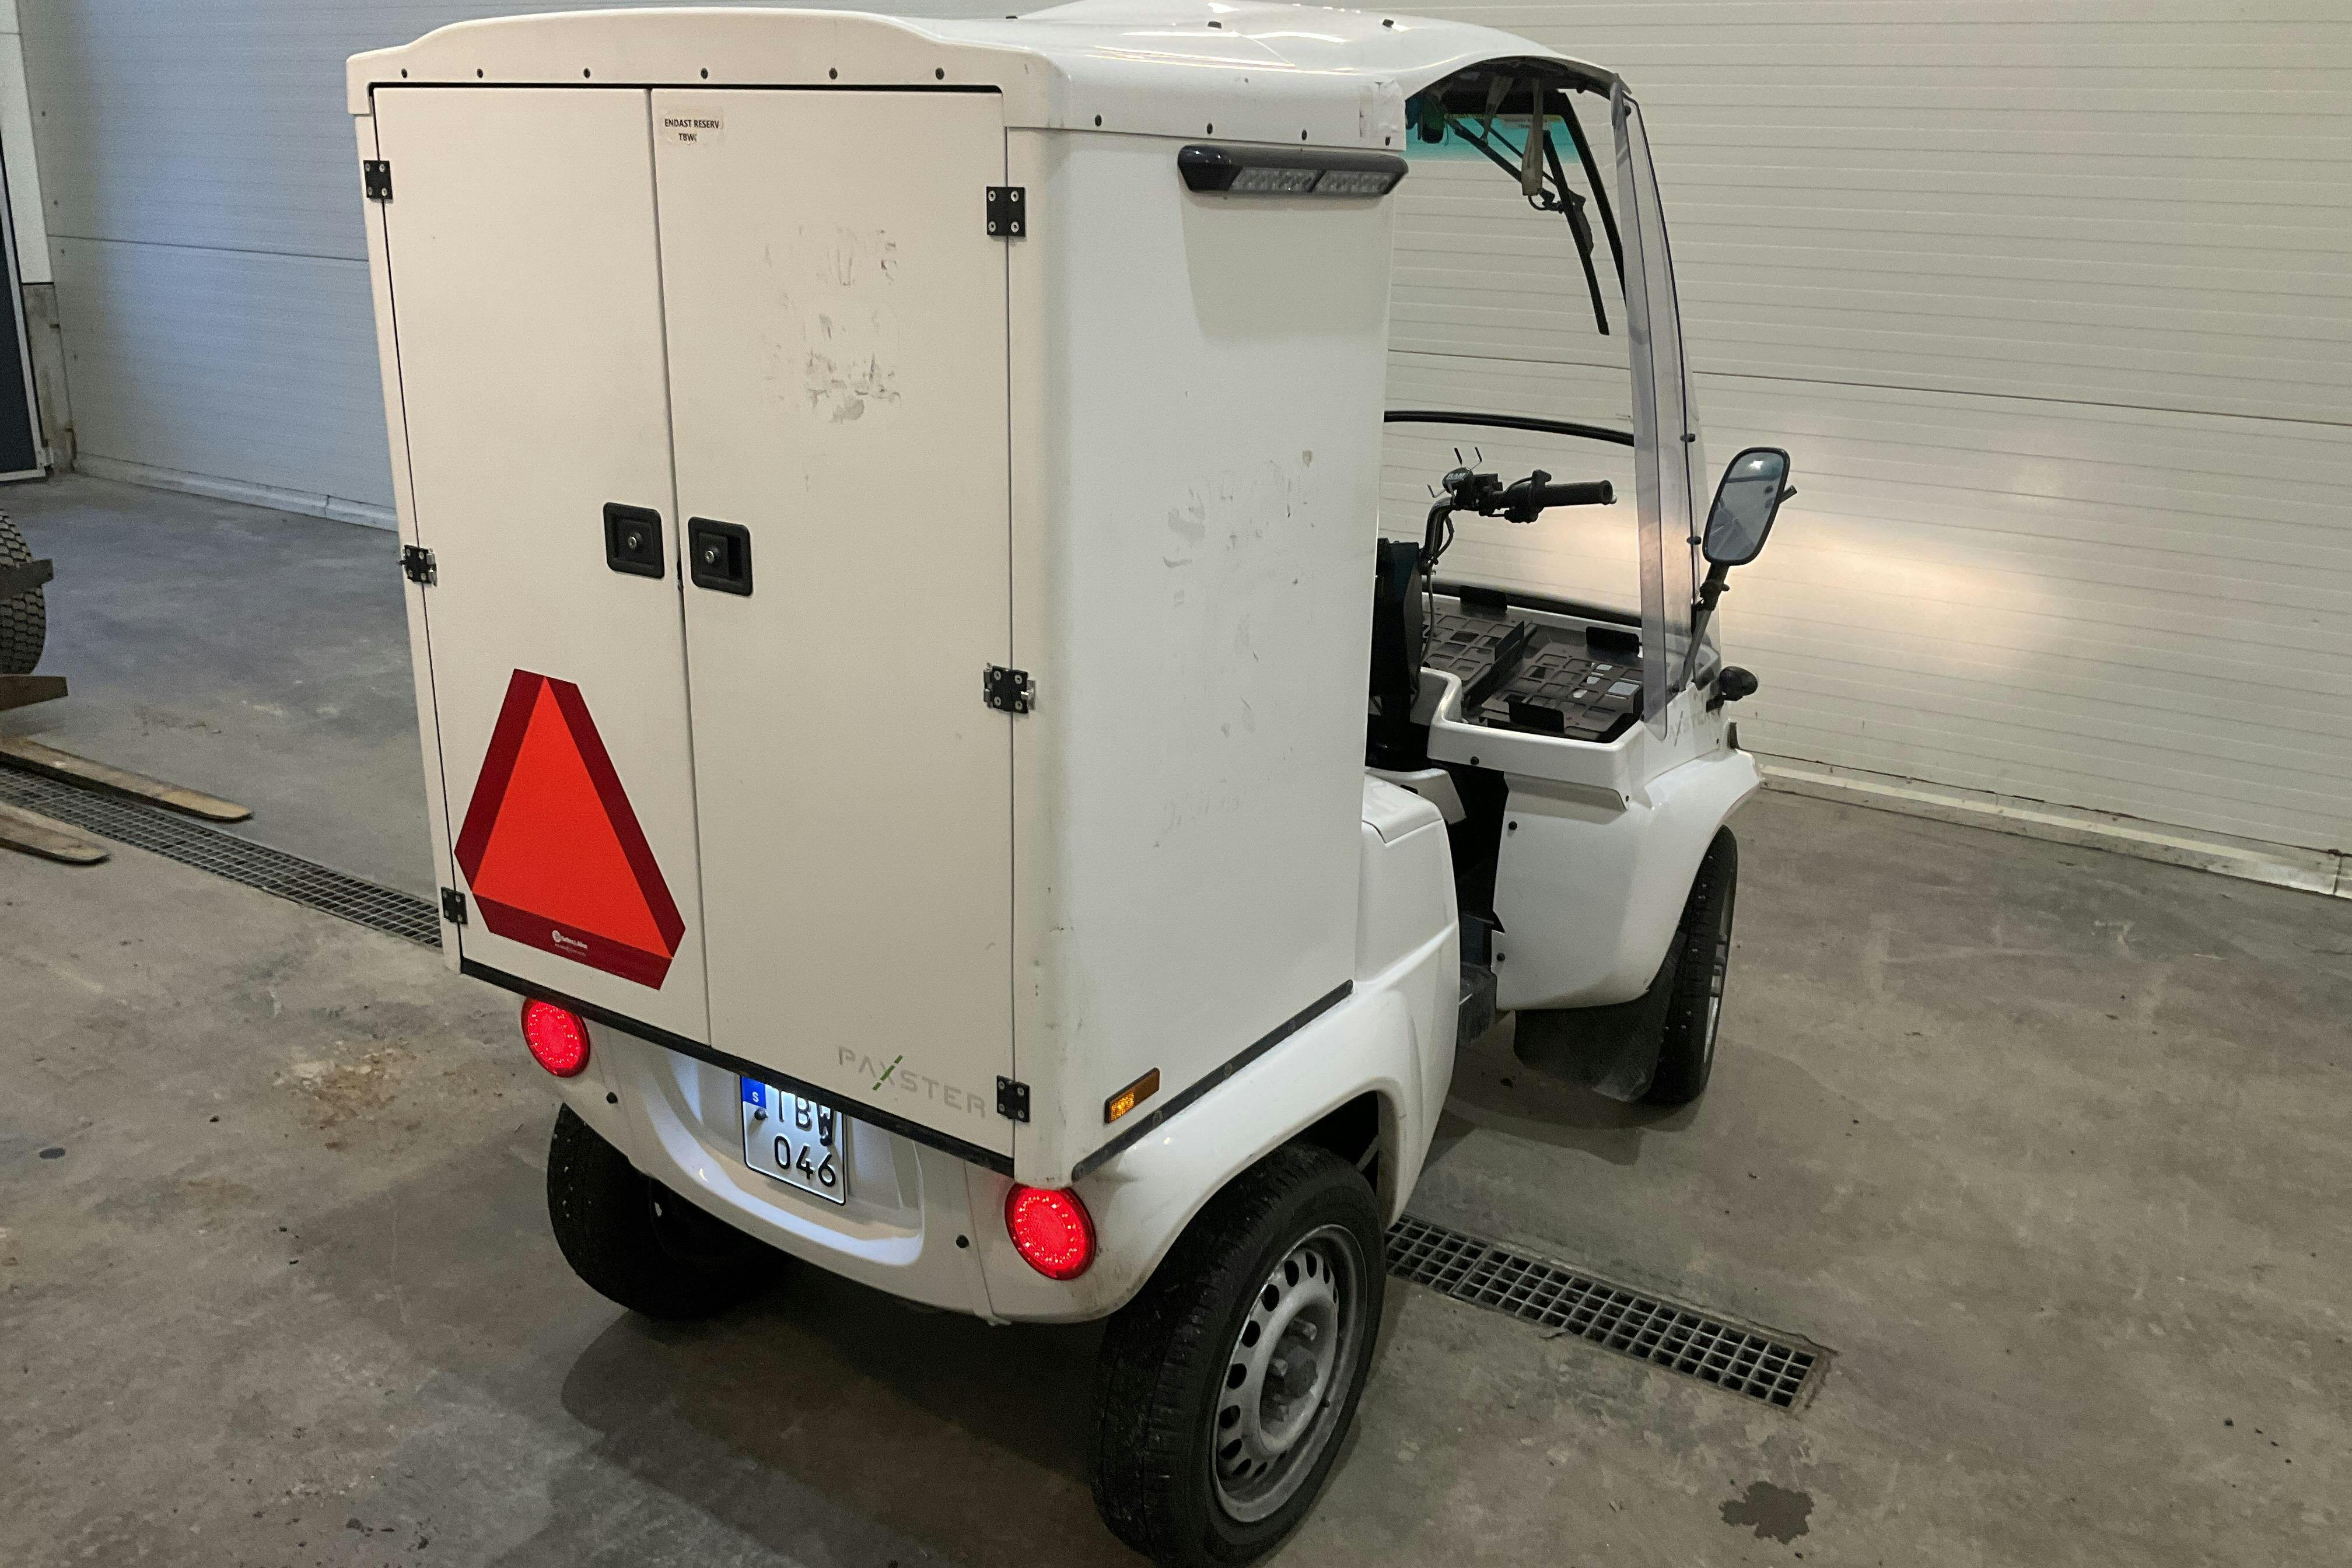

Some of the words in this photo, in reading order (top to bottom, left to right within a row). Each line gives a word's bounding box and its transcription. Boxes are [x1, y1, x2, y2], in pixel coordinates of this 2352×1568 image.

[664, 118, 692, 127] ENDAST
[694, 120, 719, 128] RESERV
[752, 1091, 759, 1102] S
[838, 1046, 985, 1118] PAXSTER
[775, 1135, 836, 1186] 046
